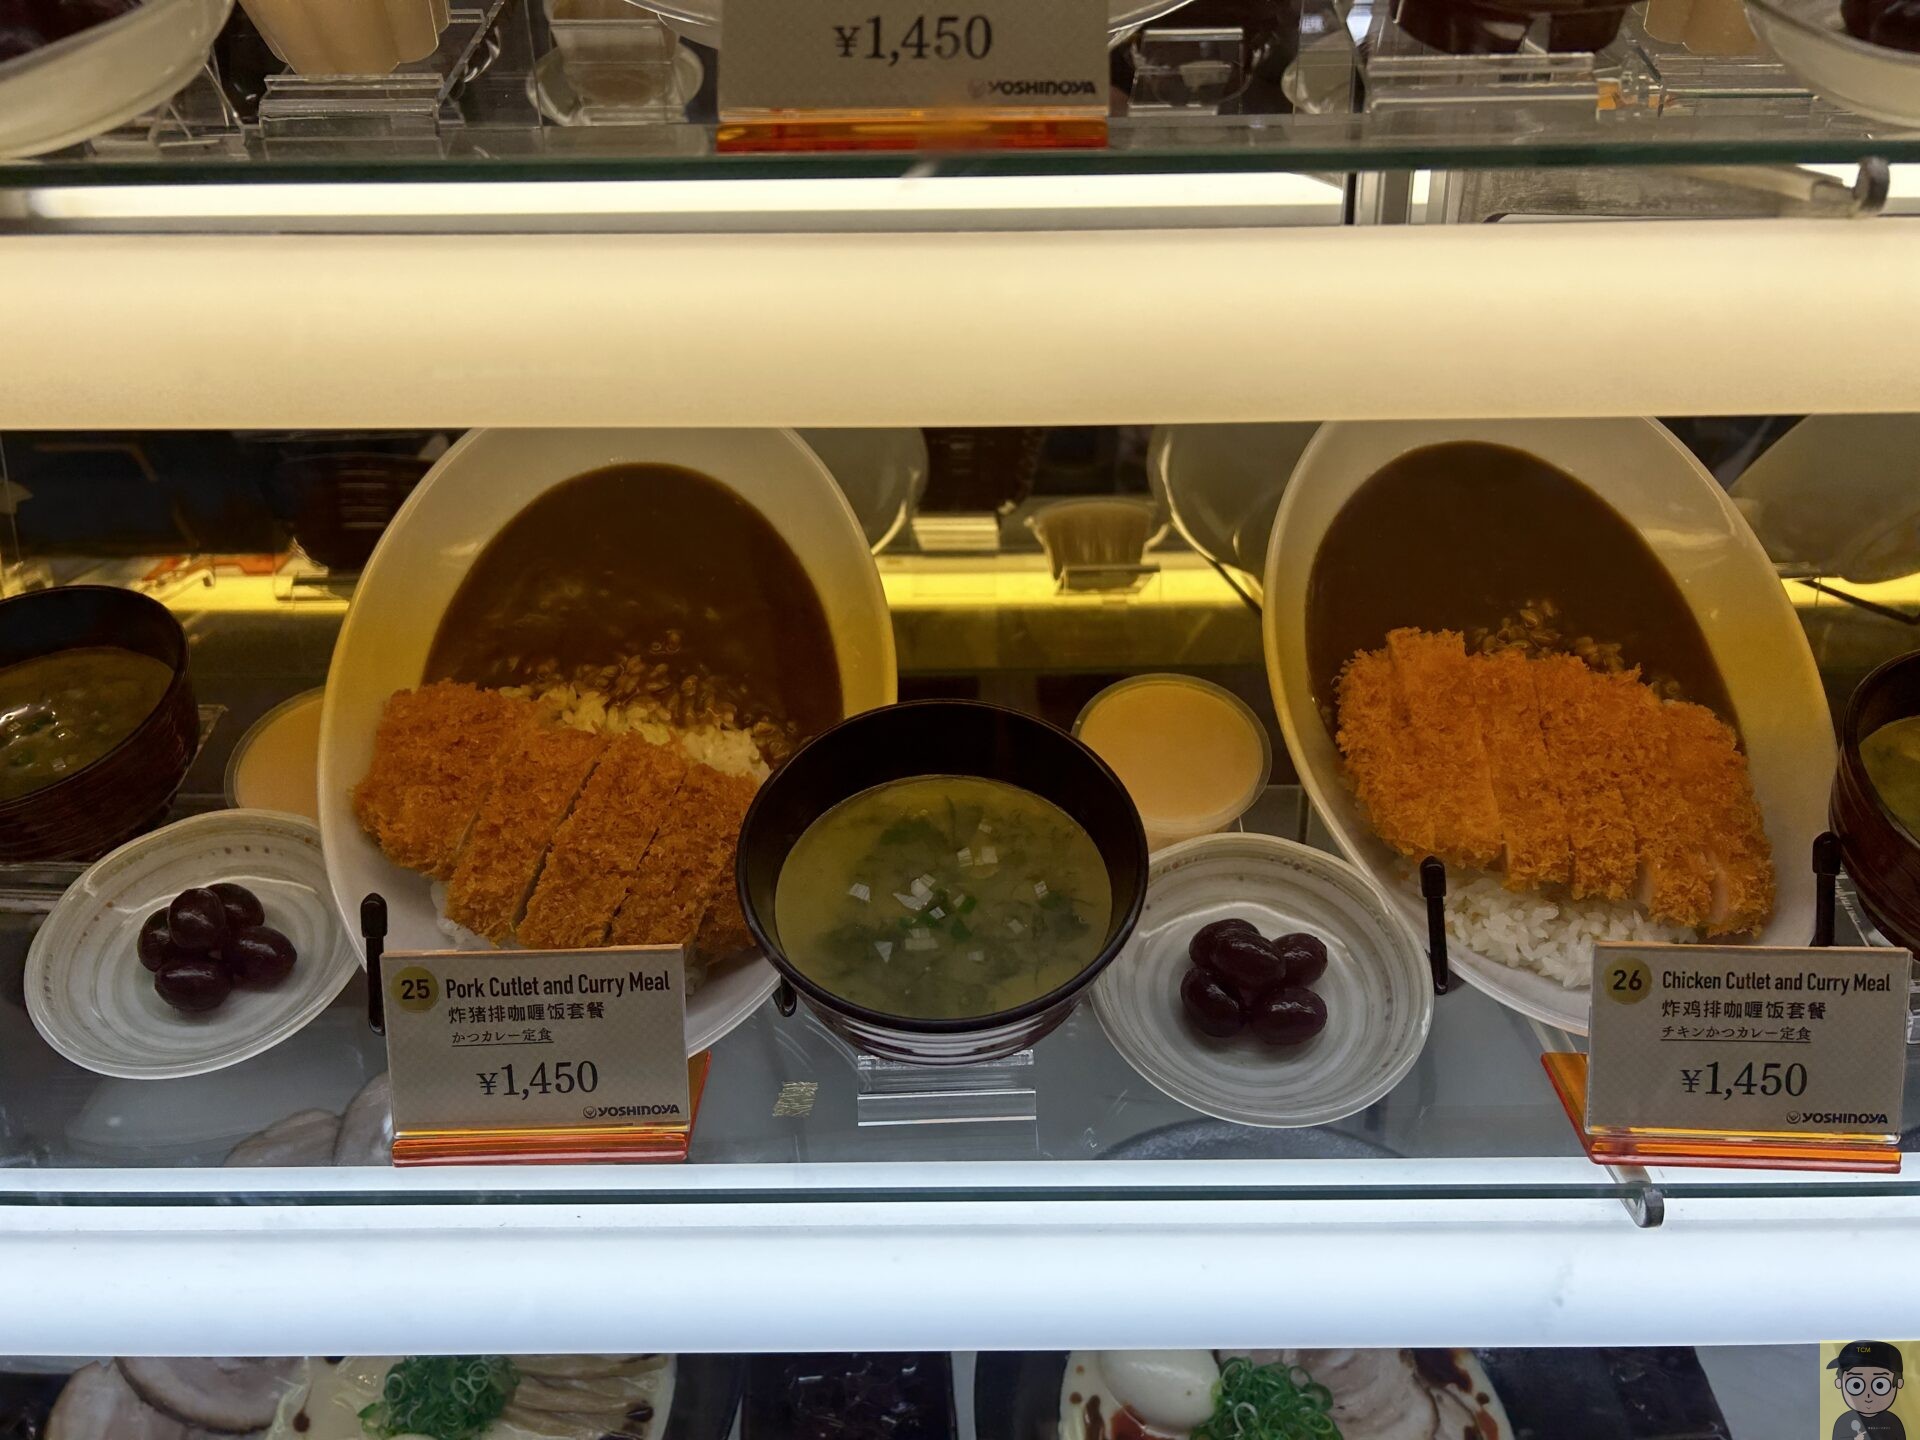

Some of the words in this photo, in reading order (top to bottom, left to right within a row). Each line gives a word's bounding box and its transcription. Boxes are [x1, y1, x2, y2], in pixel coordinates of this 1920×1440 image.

[833, 14, 993, 67] ¥1,450
[988, 80, 1096, 96] YOSHINOYA
[401, 979, 430, 1000] 25
[446, 979, 485, 998] Pork
[489, 976, 540, 997] Cutlet
[543, 974, 574, 995] and
[578, 974, 625, 997] Curry
[629, 970, 671, 992] Meal
[1612, 969, 1643, 991] 26
[1662, 970, 1721, 990] Chicken
[1726, 971, 1771, 991] Cutlet
[1775, 972, 1802, 991] and
[1807, 973, 1850, 996] Curry
[1854, 973, 1891, 992] Meal
[448, 1001, 605, 1024] 炸猪排咖喱饭套餐
[1661, 1000, 1826, 1021] 炸鸡排咖喱饭套餐
[452, 1027, 553, 1044] かつカレー定食
[1661, 1026, 1812, 1041] チキンかつカレー定食
[476, 1060, 599, 1100] ¥1,450
[1681, 1061, 1808, 1100] ¥1,450
[598, 1103, 680, 1118] YOSHINOYA
[1801, 1112, 1889, 1125] YOSHINOYA
